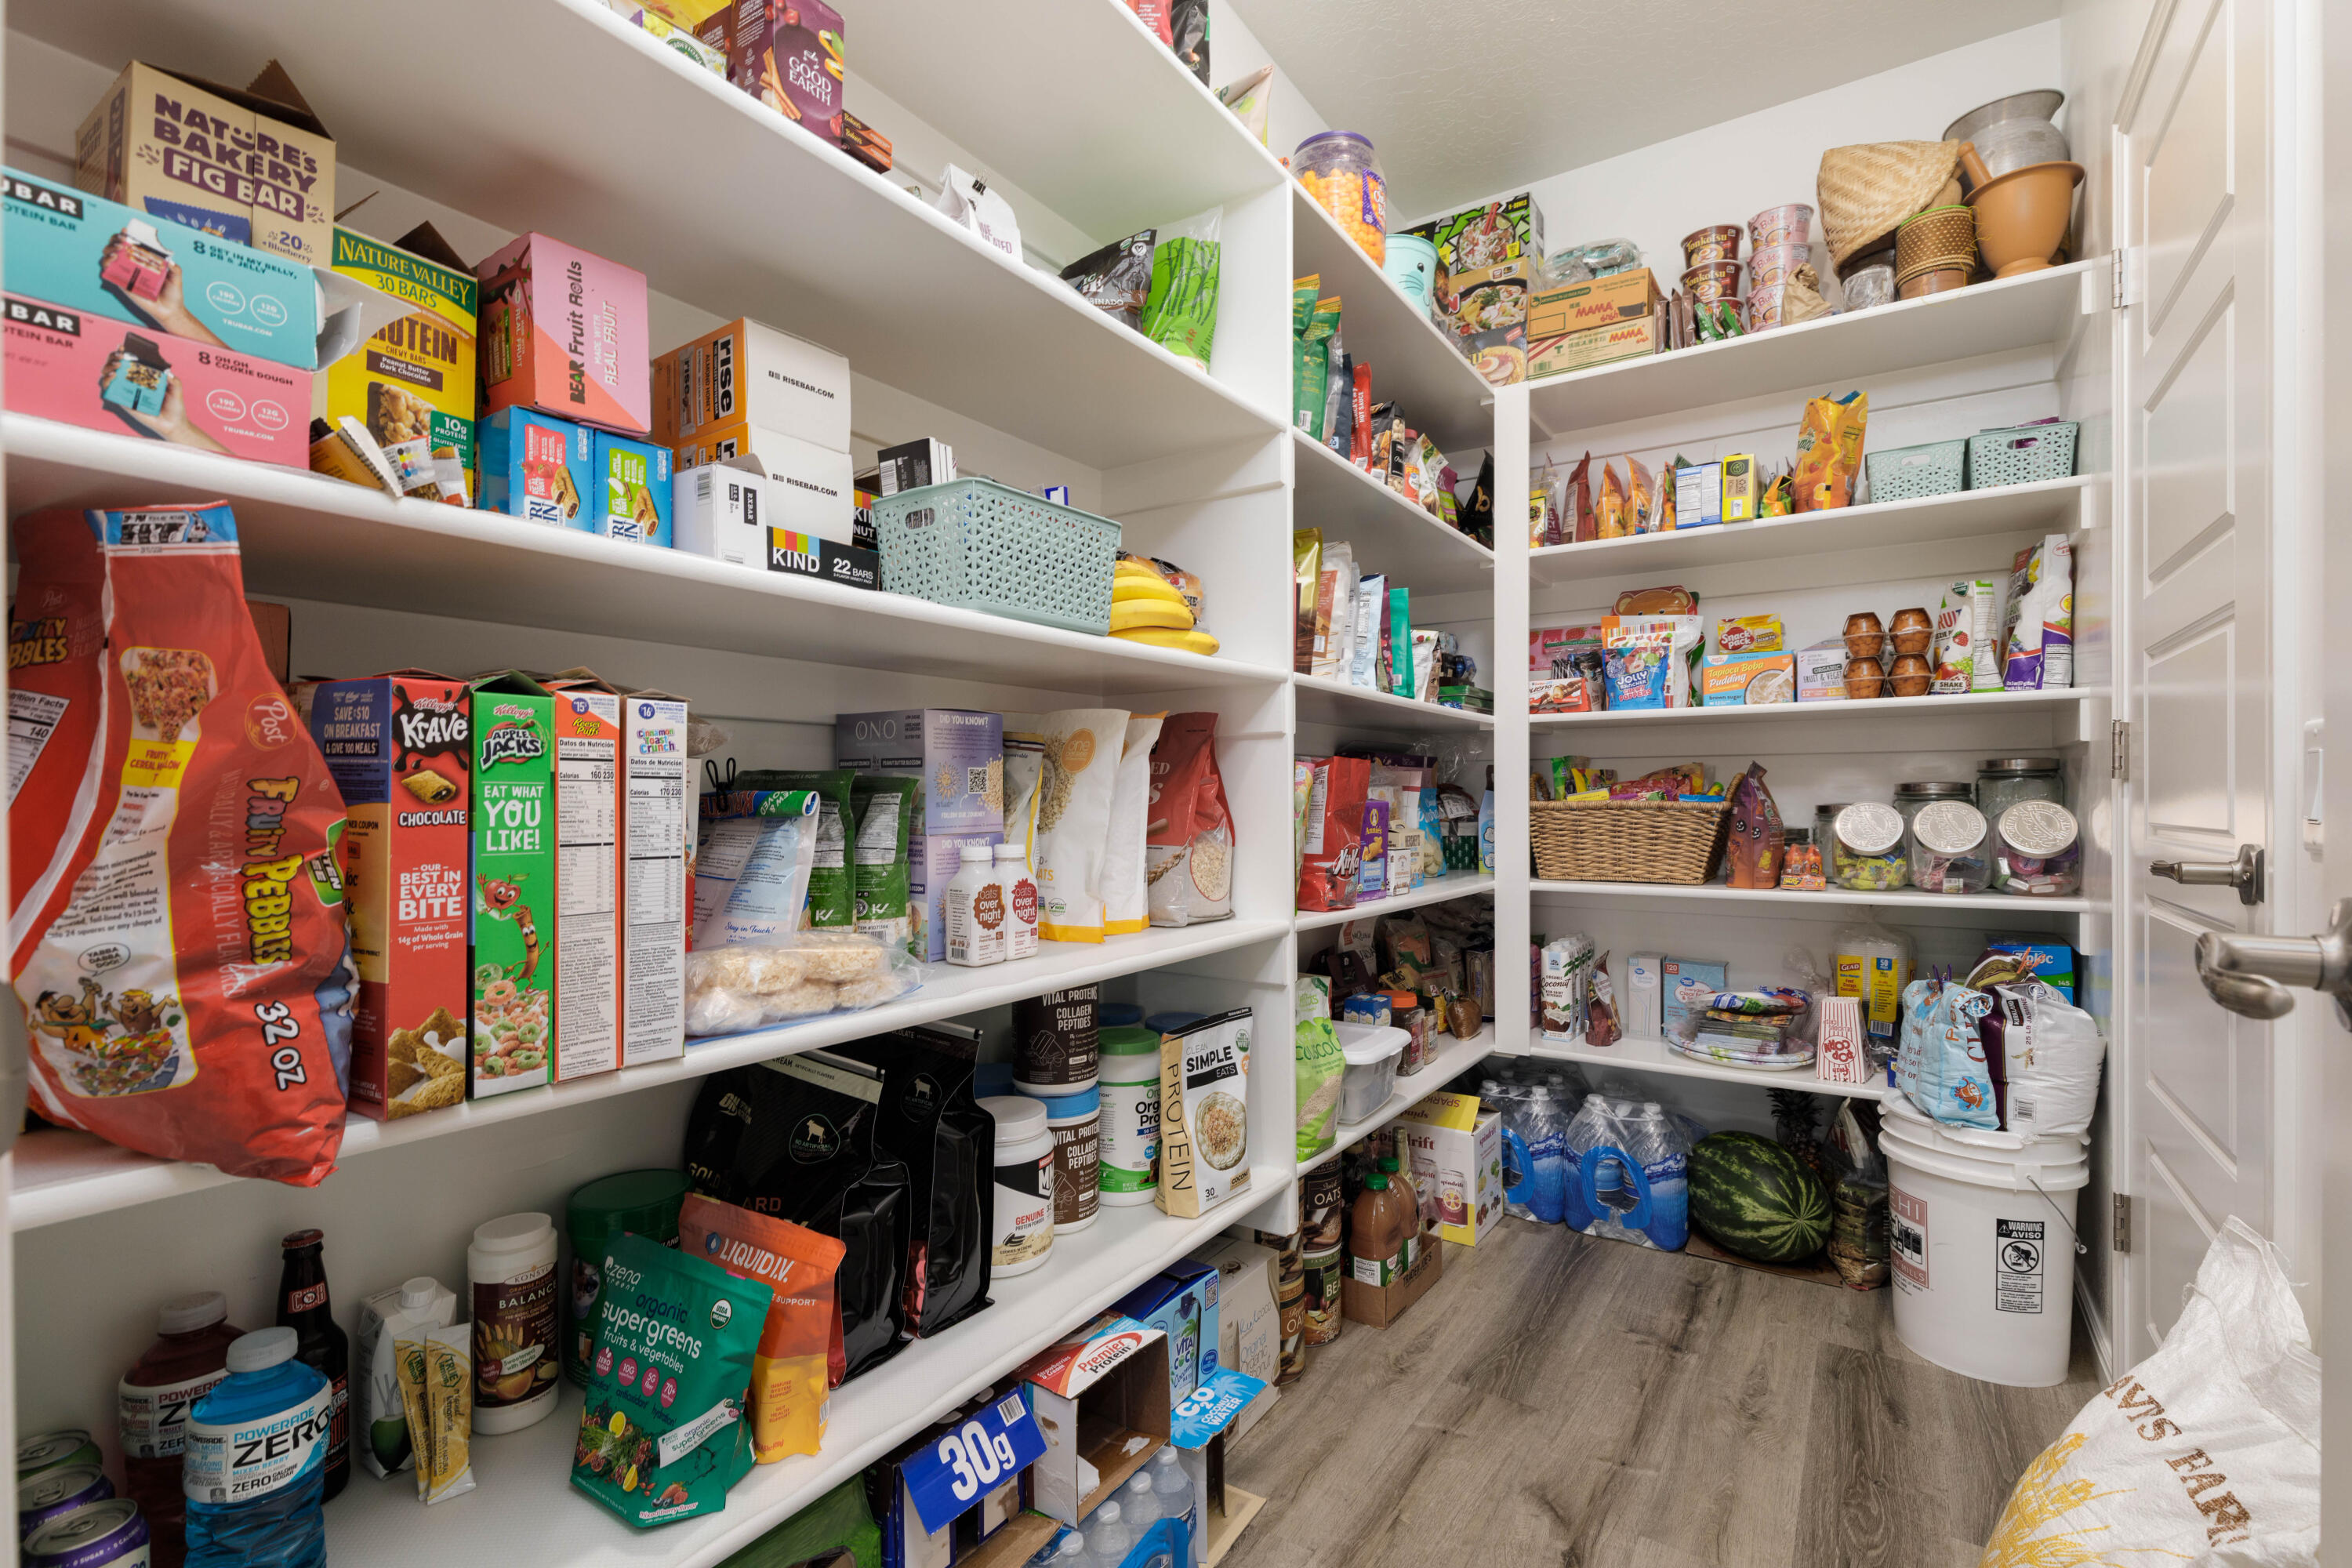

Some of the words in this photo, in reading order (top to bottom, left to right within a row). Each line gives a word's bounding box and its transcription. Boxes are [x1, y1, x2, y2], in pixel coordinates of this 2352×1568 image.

[789, 55, 833, 93] GOOD
[789, 70, 832, 106] EARTH
[154, 118, 317, 194] BAKERY
[172, 161, 226, 195] FIG
[238, 182, 297, 217] BAR
[49, 217, 77, 232] BAR
[280, 231, 303, 250] 20
[1686, 233, 1728, 252] Tonkotsu
[338, 236, 409, 277] NATURE
[412, 263, 471, 307] VALLEY
[1686, 270, 1726, 288] Tonkotsu
[375, 274, 395, 293] 30
[398, 281, 437, 308] BARS
[569, 260, 583, 307] Rolls
[0, 300, 74, 332] BAR
[1575, 301, 1614, 318] MAMA
[604, 301, 619, 345] FRUIT
[569, 310, 586, 357] Fruit
[1609, 327, 1643, 343] MAMA
[45, 336, 74, 349] BAR
[386, 345, 407, 359] CHEWY
[409, 351, 427, 366] BARS
[215, 361, 255, 376] COOKIE
[256, 372, 293, 386] DOUGH
[379, 362, 396, 375] Dark
[397, 367, 432, 383] Chocolate
[382, 356, 407, 371] Peanut
[408, 364, 430, 376] Butter
[604, 350, 619, 387] REAL
[570, 361, 586, 405] BEAR
[718, 339, 732, 413] rise
[782, 375, 834, 399] RISEBAR.COM
[223, 425, 274, 441] TRUBAR.COM
[444, 416, 467, 434] 10g
[786, 477, 837, 498] RISEBAR.COM
[773, 546, 820, 573] KIND
[833, 557, 851, 574] 22
[853, 568, 873, 579] BARS
[1721, 630, 1751, 644] Snack
[1617, 670, 1648, 685] JOLLY
[1708, 666, 1740, 677] Tapioca
[1741, 662, 1764, 672] Boba
[1803, 673, 1819, 683] FRUIT
[1709, 673, 1747, 688] Pudding
[1619, 688, 1652, 702] POPPERS
[334, 706, 353, 720] SAVE
[413, 698, 455, 712] Kellogg's
[494, 705, 535, 718] Kellogg's
[254, 701, 289, 742] Post
[324, 725, 334, 738] ON
[336, 722, 380, 737] BREAKFAST
[951, 715, 964, 724] YOU
[965, 717, 989, 728] KNOW?
[30, 726, 49, 739] 140
[493, 728, 529, 740] APPLE
[576, 726, 599, 736] Puffs
[637, 728, 674, 738] Cinnamon
[480, 739, 543, 771] JACKS
[640, 742, 675, 754] Crunch
[591, 771, 601, 779] 160
[484, 786, 506, 798] EAT
[512, 786, 544, 798] WHAT
[247, 776, 299, 857] FRUITY
[398, 810, 466, 827] CHOCOLATE
[483, 800, 541, 826] YOU
[1366, 826, 1382, 835] Annie's
[486, 829, 540, 851] LIKE!
[953, 838, 966, 848] YOU
[400, 872, 441, 885] BEST
[445, 870, 461, 882] IN
[400, 883, 462, 899] EVERY
[242, 854, 303, 965] PEBBLES
[398, 896, 463, 920] BITE
[980, 899, 998, 909] over
[1015, 897, 1033, 906] over
[980, 909, 1000, 923] night
[1016, 906, 1036, 919] night
[420, 933, 444, 942] Whole
[445, 931, 463, 940] Grain
[86, 946, 118, 958] YABBA
[425, 941, 448, 951] serving
[1042, 991, 1065, 1007] VITAL
[1056, 1004, 1092, 1019] COLLAGEN
[2009, 1000, 2020, 1025] KIRKLAND
[2021, 997, 2032, 1024] JASMINE
[255, 1000, 299, 1046] 32
[1058, 1016, 1091, 1031] PEPTIDES
[1186, 1042, 1208, 1056] CLEAN
[1824, 1039, 1850, 1054] CORN
[1186, 1046, 1232, 1073] SIMPLE
[1832, 1049, 1854, 1063] POP
[270, 1047, 307, 1091] OZ
[1216, 1065, 1236, 1078] EATS
[1166, 1062, 1193, 1192] PROTEIN
[1053, 1129, 1076, 1146] VITAL
[1067, 1138, 1098, 1159] COLLAGEN
[1069, 1151, 1098, 1170] PEPTIDES
[1205, 1188, 1215, 1199] 30
[1314, 1189, 1341, 1206] OATS
[1015, 1208, 1044, 1225] GENUINE
[2008, 1221, 2042, 1232] WARNING
[720, 1237, 773, 1276] LIQUID
[1900, 1264, 1925, 1282] MILLS
[499, 1279, 557, 1309] BALANCE
[776, 1295, 817, 1307] SUPPORT
[636, 1294, 688, 1323] organic
[717, 1305, 728, 1314] USDA
[602, 1301, 702, 1359] supergreens
[604, 1327, 628, 1348] fruits
[630, 1339, 636, 1352] &
[639, 1345, 684, 1374] vegetables
[1176, 1337, 1193, 1352] VITA
[503, 1348, 535, 1367] Sweetened
[507, 1363, 518, 1371] with
[519, 1355, 535, 1367] Stevia
[598, 1356, 610, 1365] ZERO
[1078, 1339, 1125, 1372] Premier
[1089, 1345, 1131, 1374] Protein
[596, 1363, 609, 1371] SUGAR
[622, 1364, 634, 1374] 10G
[1037, 1355, 1072, 1376] Strawberries
[648, 1373, 655, 1382] 5G
[1201, 1394, 1232, 1424] COCONUT
[1209, 1398, 1243, 1425] WATER
[234, 1406, 315, 1443] POWERADE
[233, 1404, 330, 1468] ZERO
[233, 1465, 260, 1475] MIXED
[262, 1454, 289, 1468] BERRY
[939, 1421, 1016, 1501] 30g
[272, 1464, 298, 1478] CALORIE
[273, 1470, 294, 1483] SUGAR
[231, 1475, 271, 1494] ZERO
